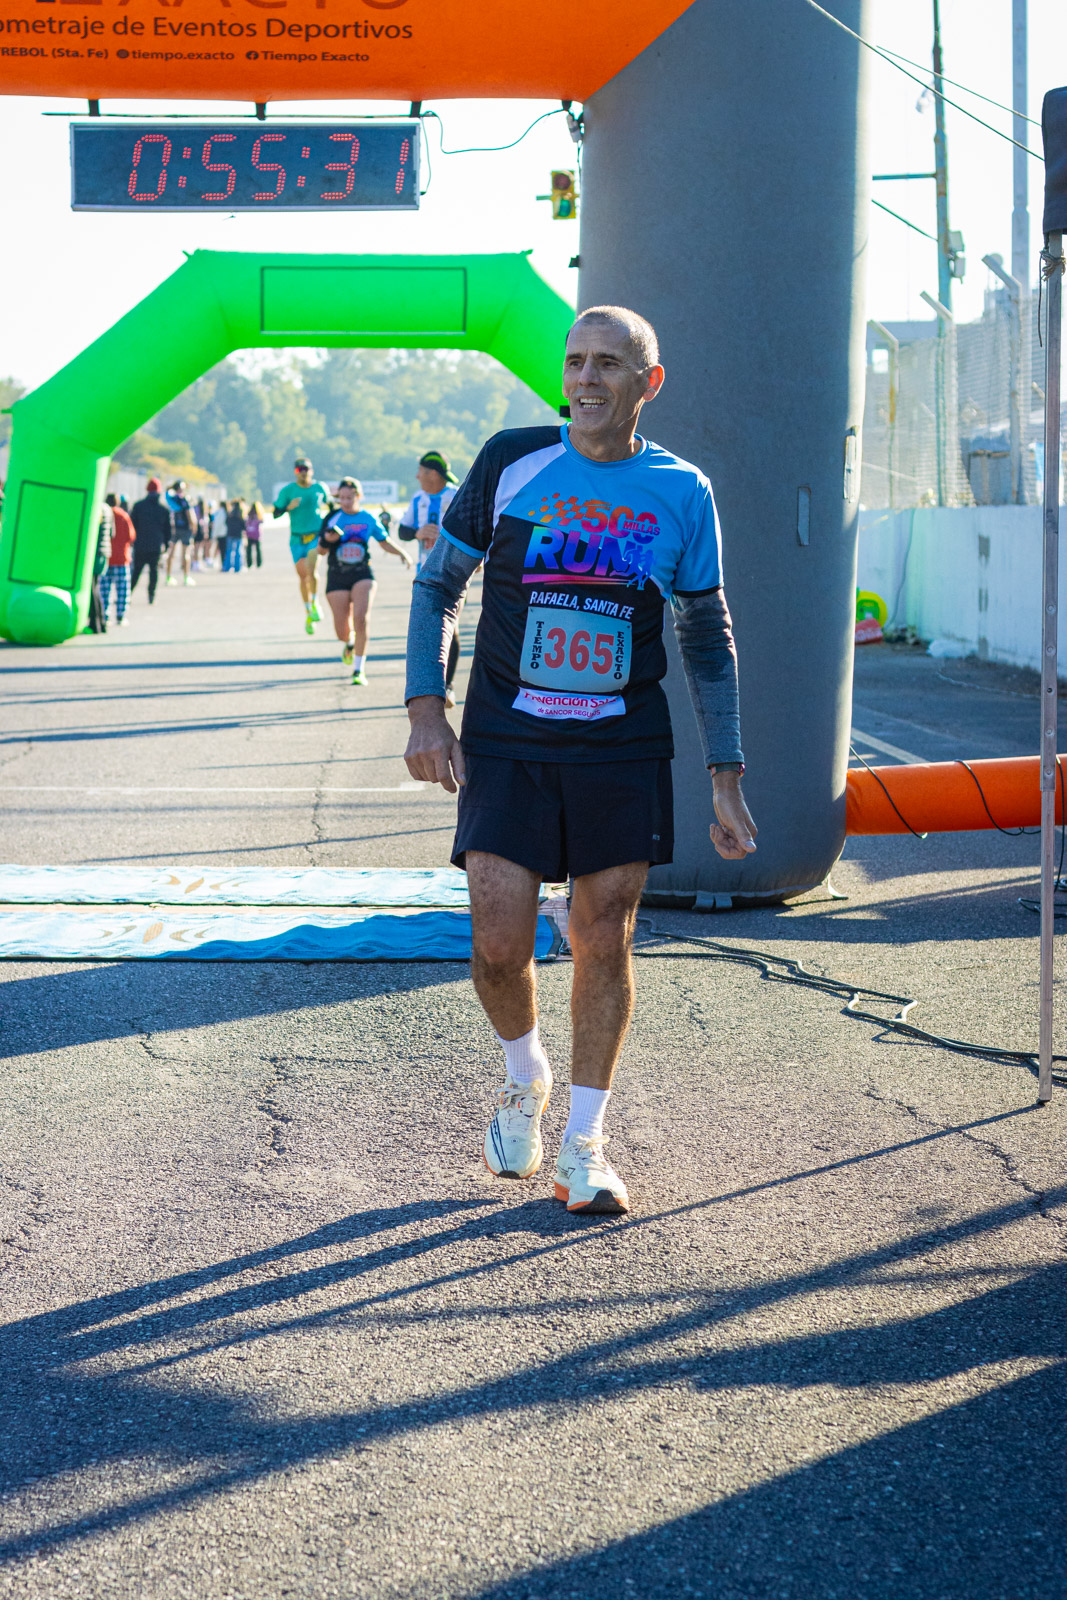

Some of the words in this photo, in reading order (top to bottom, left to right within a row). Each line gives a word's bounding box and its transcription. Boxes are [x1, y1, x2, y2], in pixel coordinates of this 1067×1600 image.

[112, 15, 145, 36] de
[153, 16, 257, 37] Eventos
[266, 18, 413, 42] Deportivos
[0, 46, 48, 57] REBOL
[51, 47, 84, 59] (Sta.
[87, 48, 109, 59] Fe)
[132, 49, 235, 61] tiempo.exacto
[261, 50, 318, 62] Tiempo
[321, 51, 370, 62] Exacto
[127, 133, 410, 201] 0:55:31
[580, 498, 658, 545] 500
[622, 520, 661, 536] MILLAS
[523, 525, 637, 577] RUN
[529, 590, 581, 611] RAFAELA,
[583, 597, 620, 617] SANTA
[618, 605, 635, 620] FE
[530, 620, 545, 669] TIEMPO
[543, 626, 615, 675] 365
[613, 631, 625, 680] EXACTO
[545, 708, 572, 716] SANCOR
